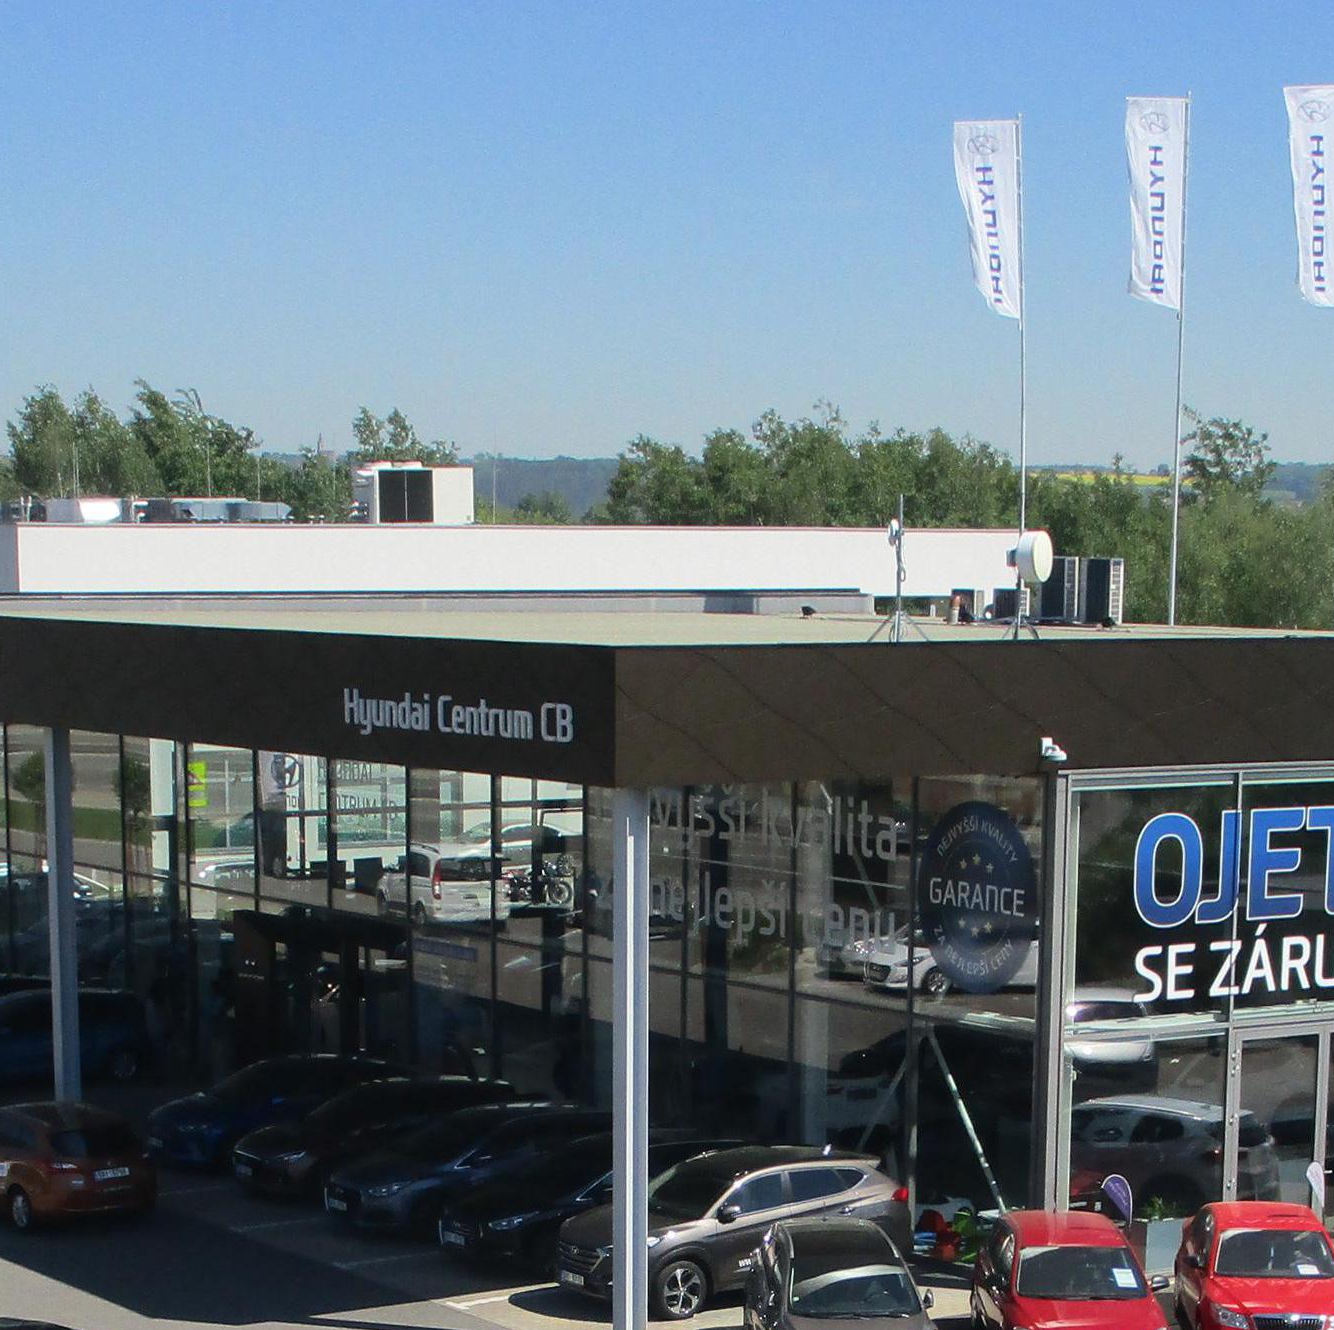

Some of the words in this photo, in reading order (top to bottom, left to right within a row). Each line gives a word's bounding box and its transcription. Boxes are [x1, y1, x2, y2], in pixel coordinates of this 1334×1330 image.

[343, 687, 430, 736] Hyundai
[437, 694, 534, 741] Centrum
[540, 702, 574, 743] CB
[928, 876, 1026, 918] GARANCE
[1133, 941, 1196, 1004] SE
